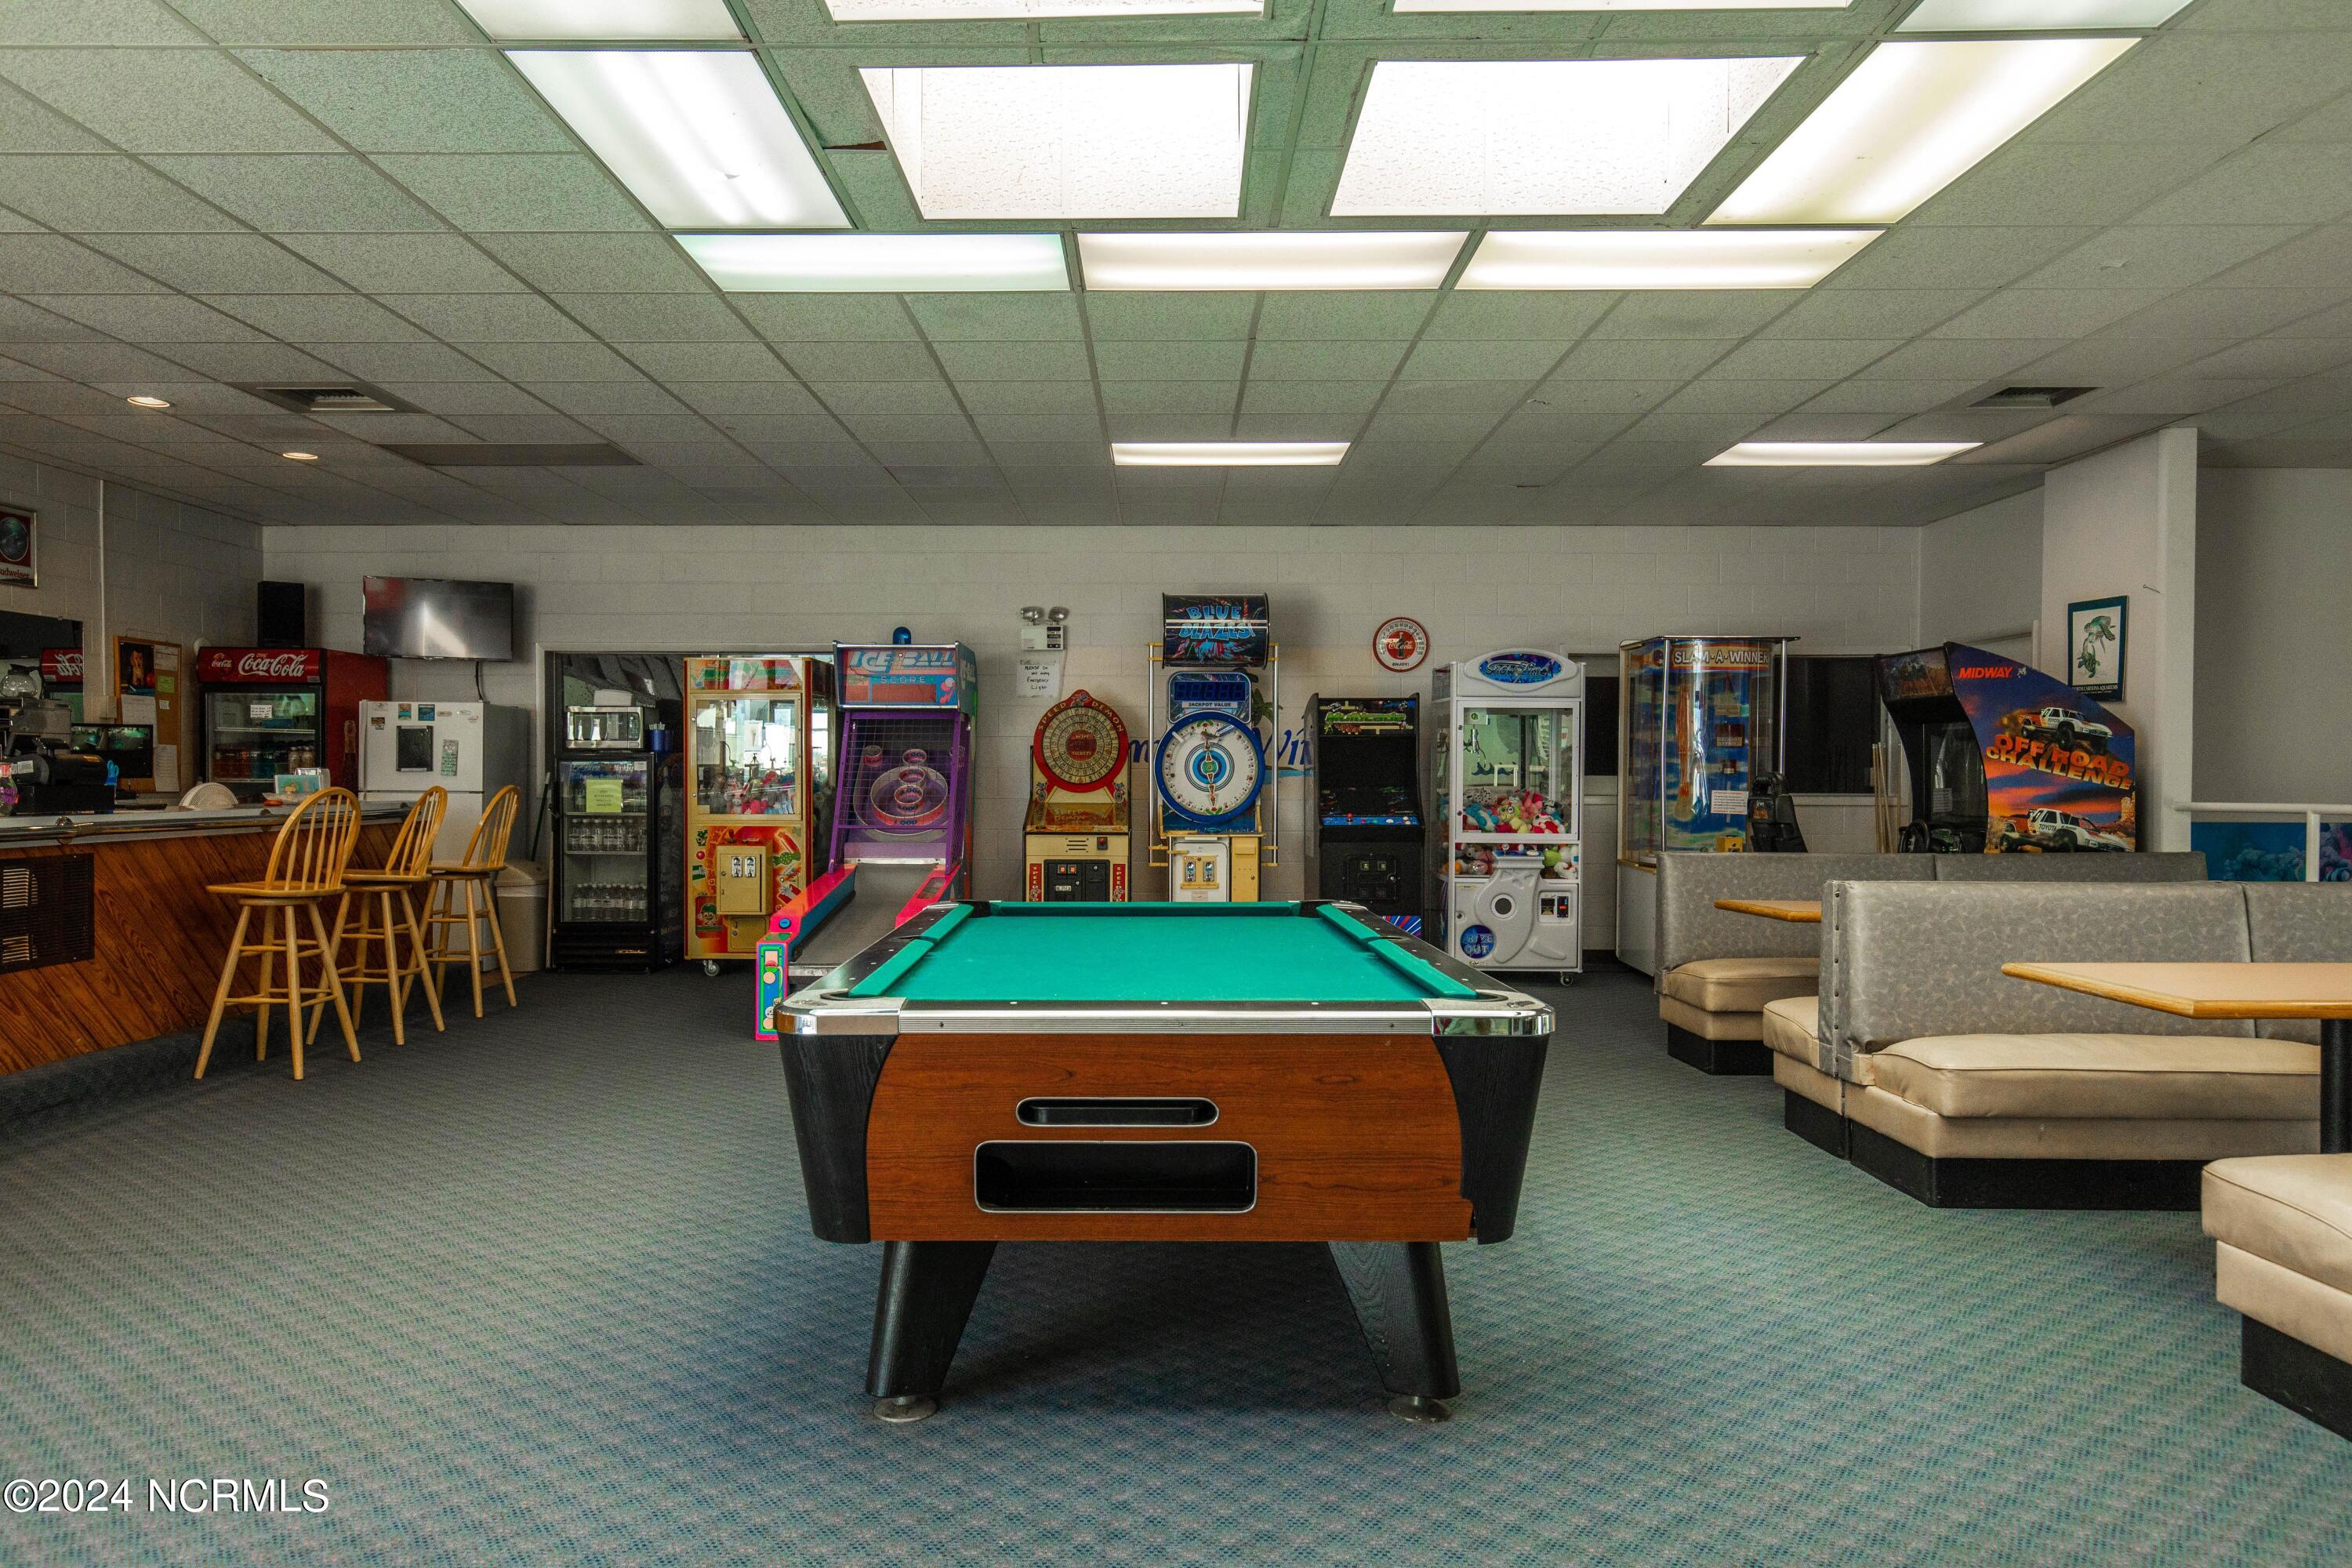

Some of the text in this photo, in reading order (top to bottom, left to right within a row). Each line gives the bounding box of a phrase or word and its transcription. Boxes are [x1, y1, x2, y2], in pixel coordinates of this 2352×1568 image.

[0, 568, 30, 579] udweiser
[1186, 605, 1242, 620] BLUE
[238, 653, 308, 677] Coca-Cola
[850, 652, 955, 673] ICE BALL
[1958, 667, 2013, 679] MIDWAY
[1038, 701, 1124, 732] SPEED DEMON
[1994, 734, 2130, 777] OFF ROAD
[1986, 746, 2133, 790] CHALLENGE
